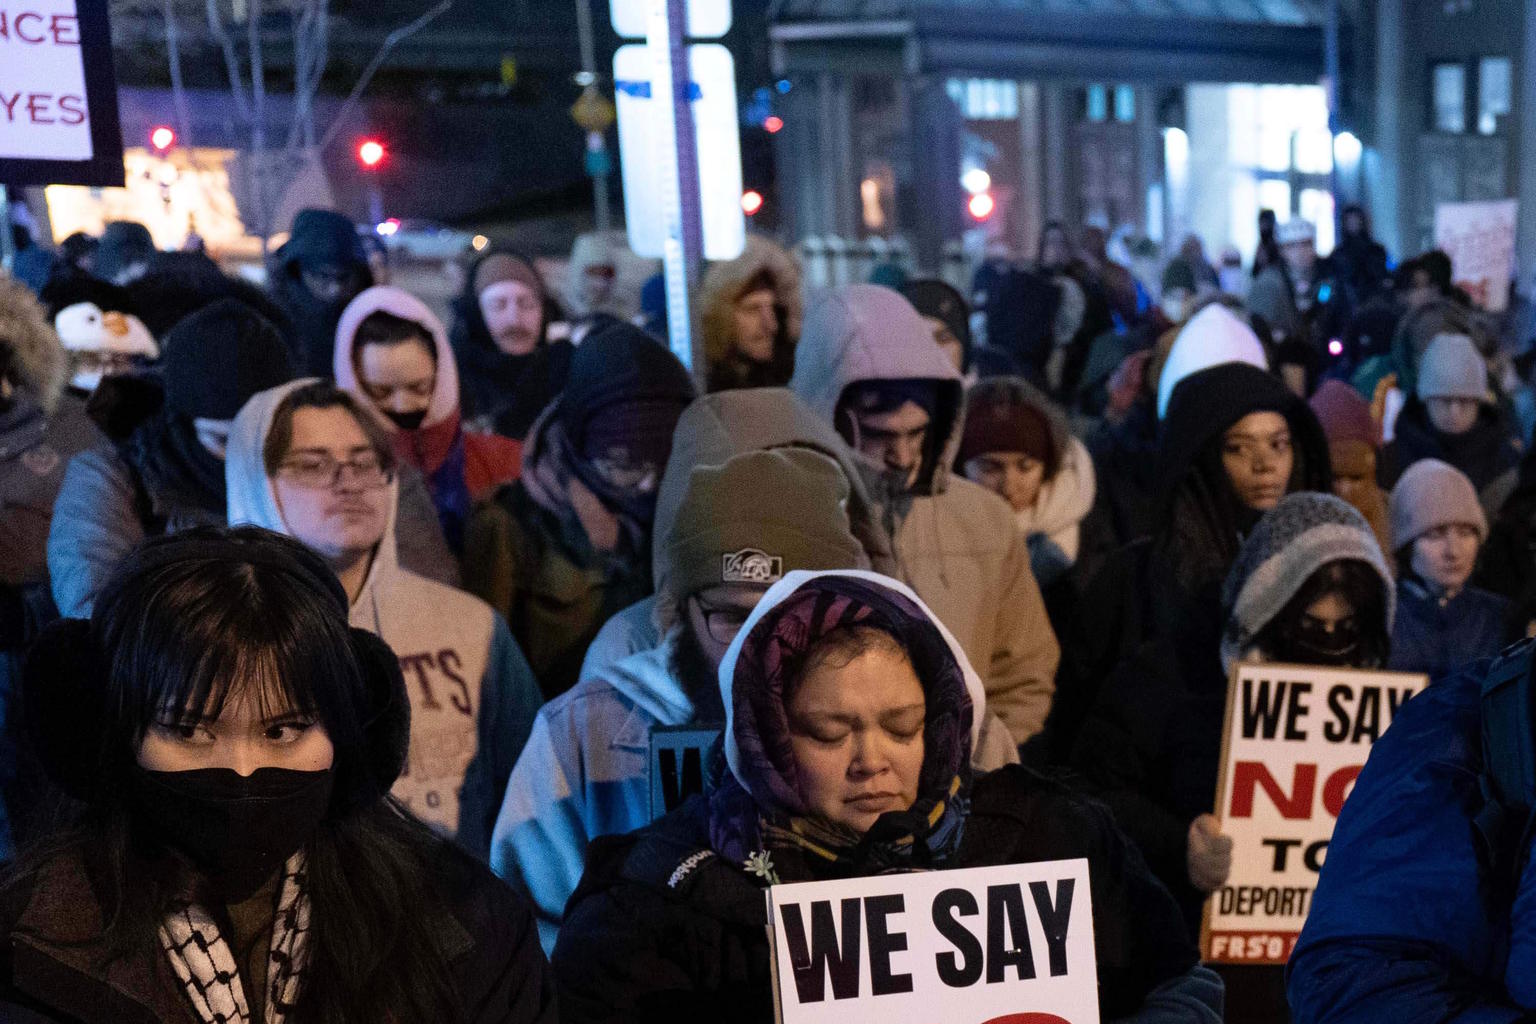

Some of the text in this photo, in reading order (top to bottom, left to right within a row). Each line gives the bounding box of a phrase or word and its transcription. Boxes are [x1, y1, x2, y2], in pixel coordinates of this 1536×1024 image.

[1242, 679, 1312, 741] WE
[1219, 886, 1309, 915] DEPORT
[780, 878, 1076, 1004] WE SAY
[1210, 934, 1283, 959] FRSO
